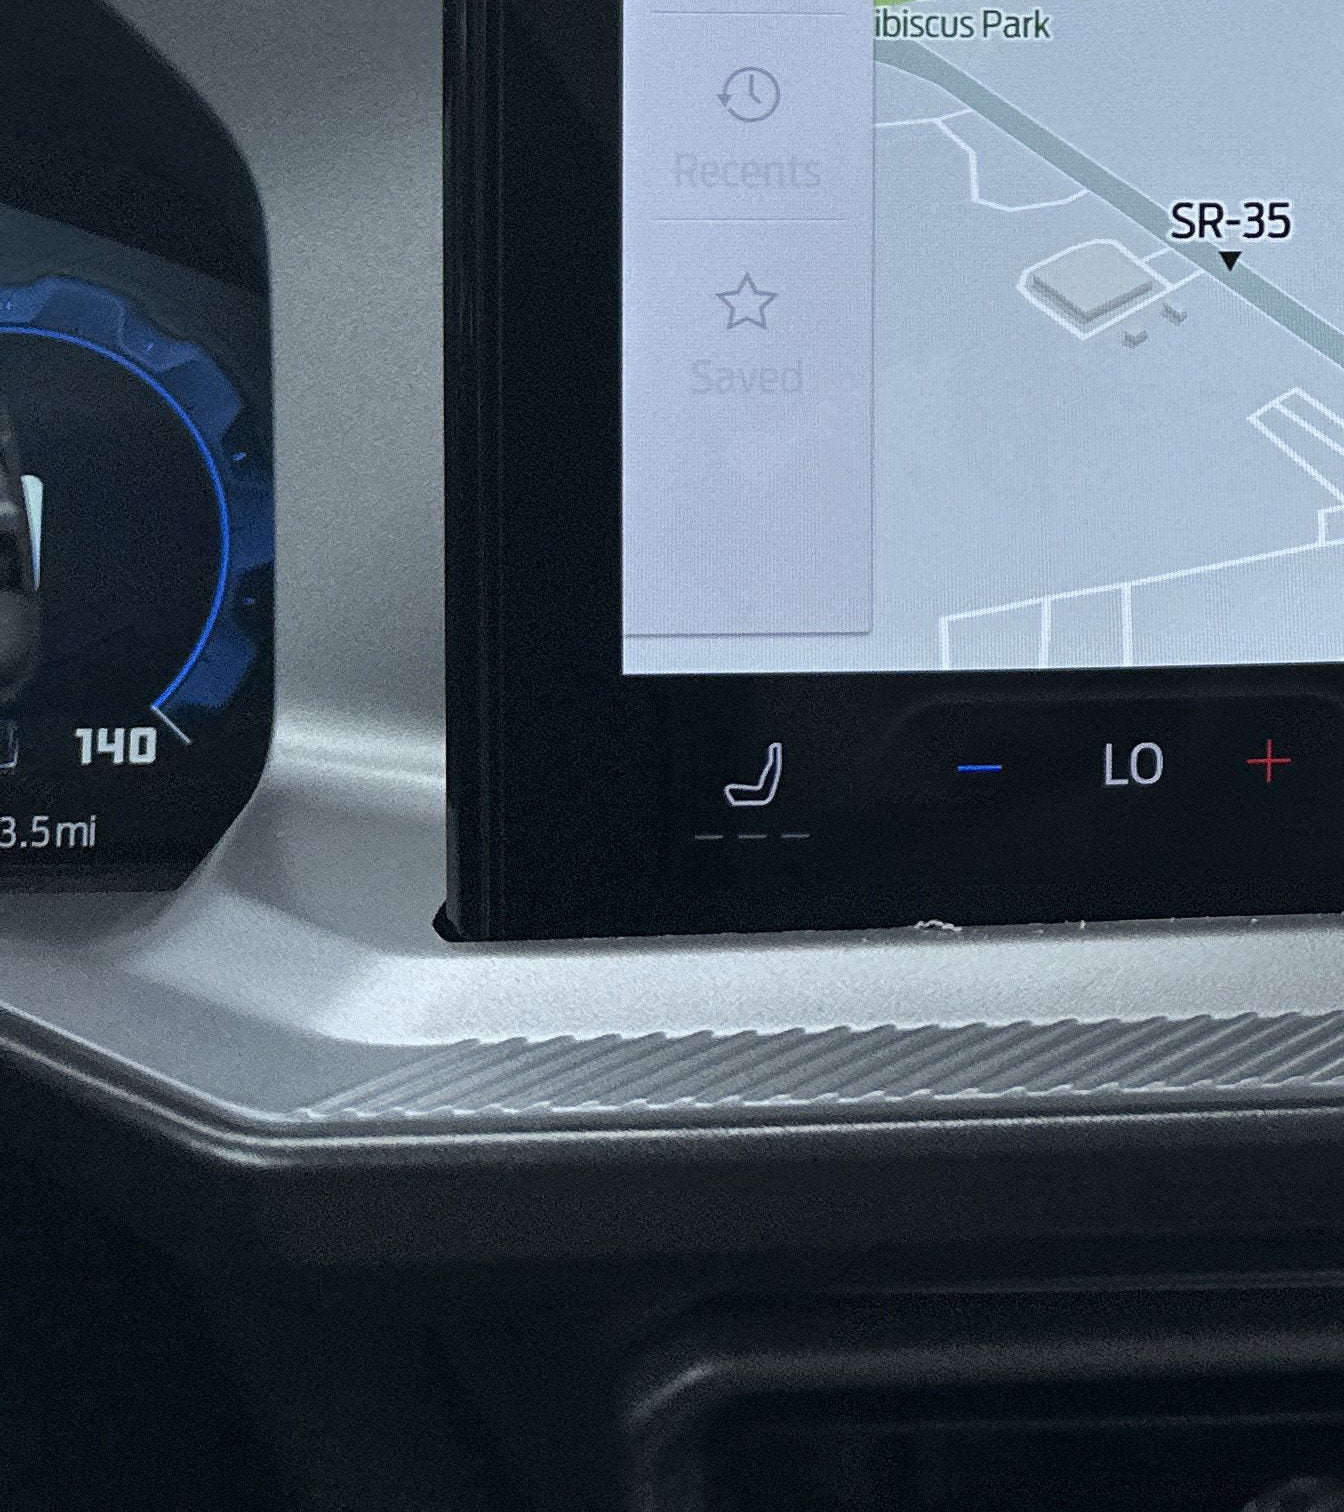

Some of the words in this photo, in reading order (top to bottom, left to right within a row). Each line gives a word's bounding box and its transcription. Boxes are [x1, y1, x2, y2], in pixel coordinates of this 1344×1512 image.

[875, 7, 975, 38] ibiscus
[983, 9, 1050, 39] Park
[673, 151, 822, 189] Recents
[1170, 202, 1292, 240] SR-35
[690, 358, 804, 396] Saved
[74, 727, 158, 765] 140
[1103, 741, 1164, 786] LO
